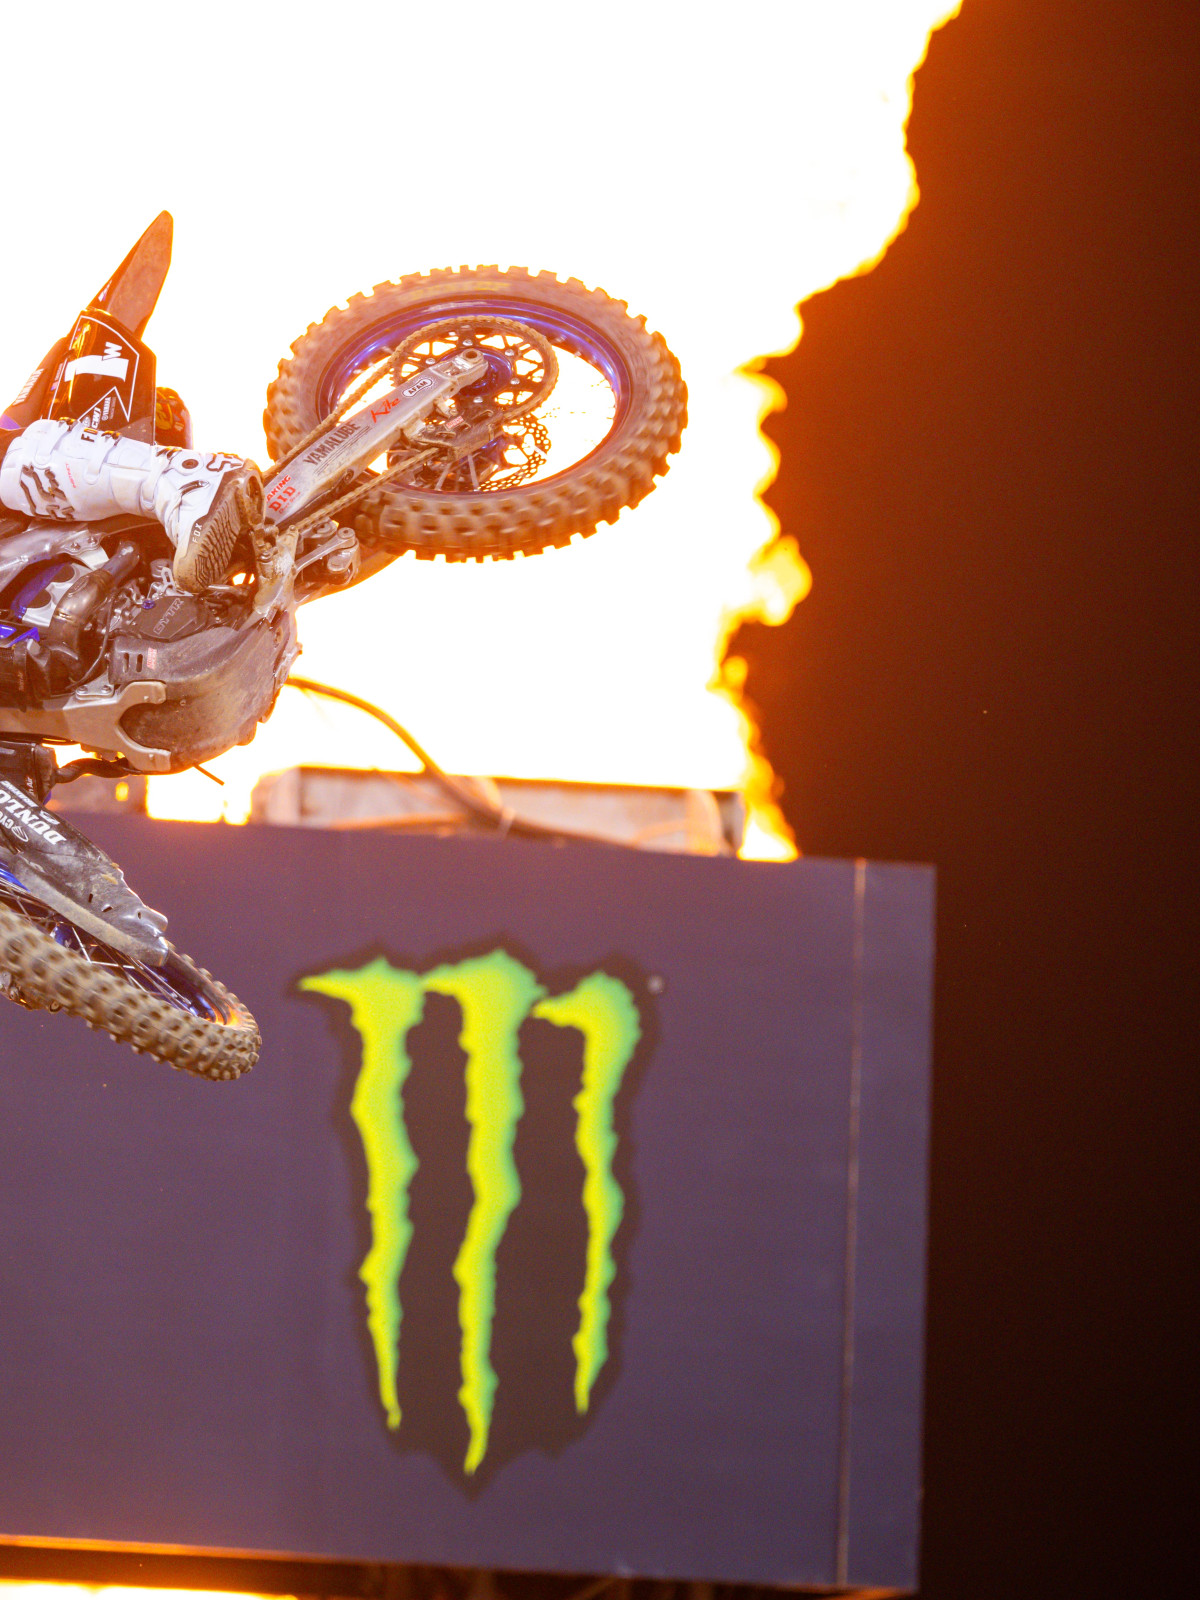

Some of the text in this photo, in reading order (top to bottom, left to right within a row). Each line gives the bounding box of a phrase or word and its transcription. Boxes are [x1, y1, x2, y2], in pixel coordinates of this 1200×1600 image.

[64, 354, 129, 382] 1
[407, 379, 428, 395] AFAM
[370, 398, 400, 424] Kite
[303, 420, 360, 466] YAMALUBE
[266, 474, 292, 504] AKING
[268, 486, 297, 512] DID
[192, 522, 203, 544] FOX
